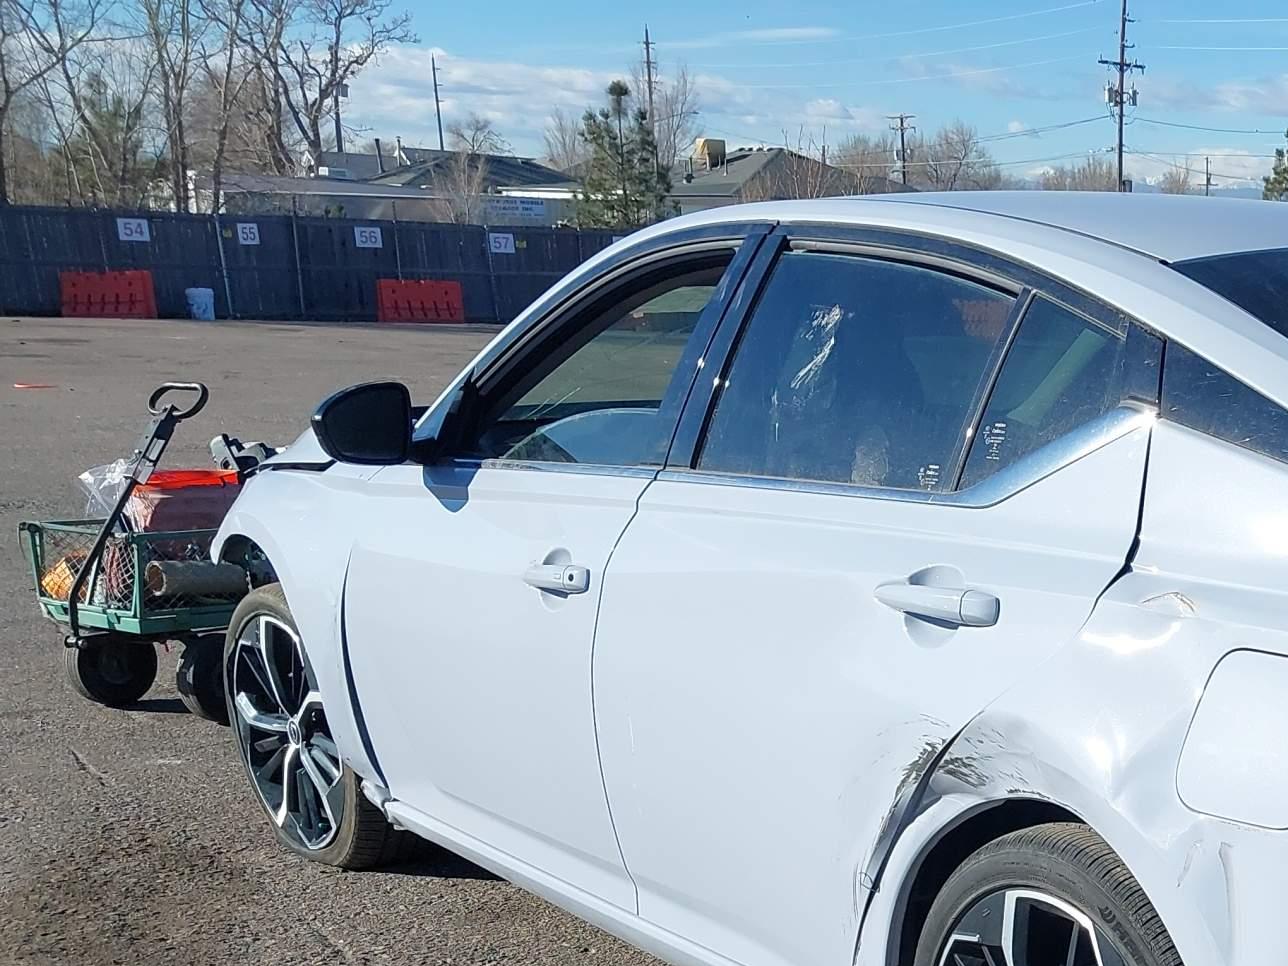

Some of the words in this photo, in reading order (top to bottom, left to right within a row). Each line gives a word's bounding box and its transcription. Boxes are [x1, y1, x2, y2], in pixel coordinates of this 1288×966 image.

[123, 223, 144, 237] 54
[241, 227, 256, 241] 55
[359, 231, 378, 244] 56
[493, 237, 510, 249] 57
